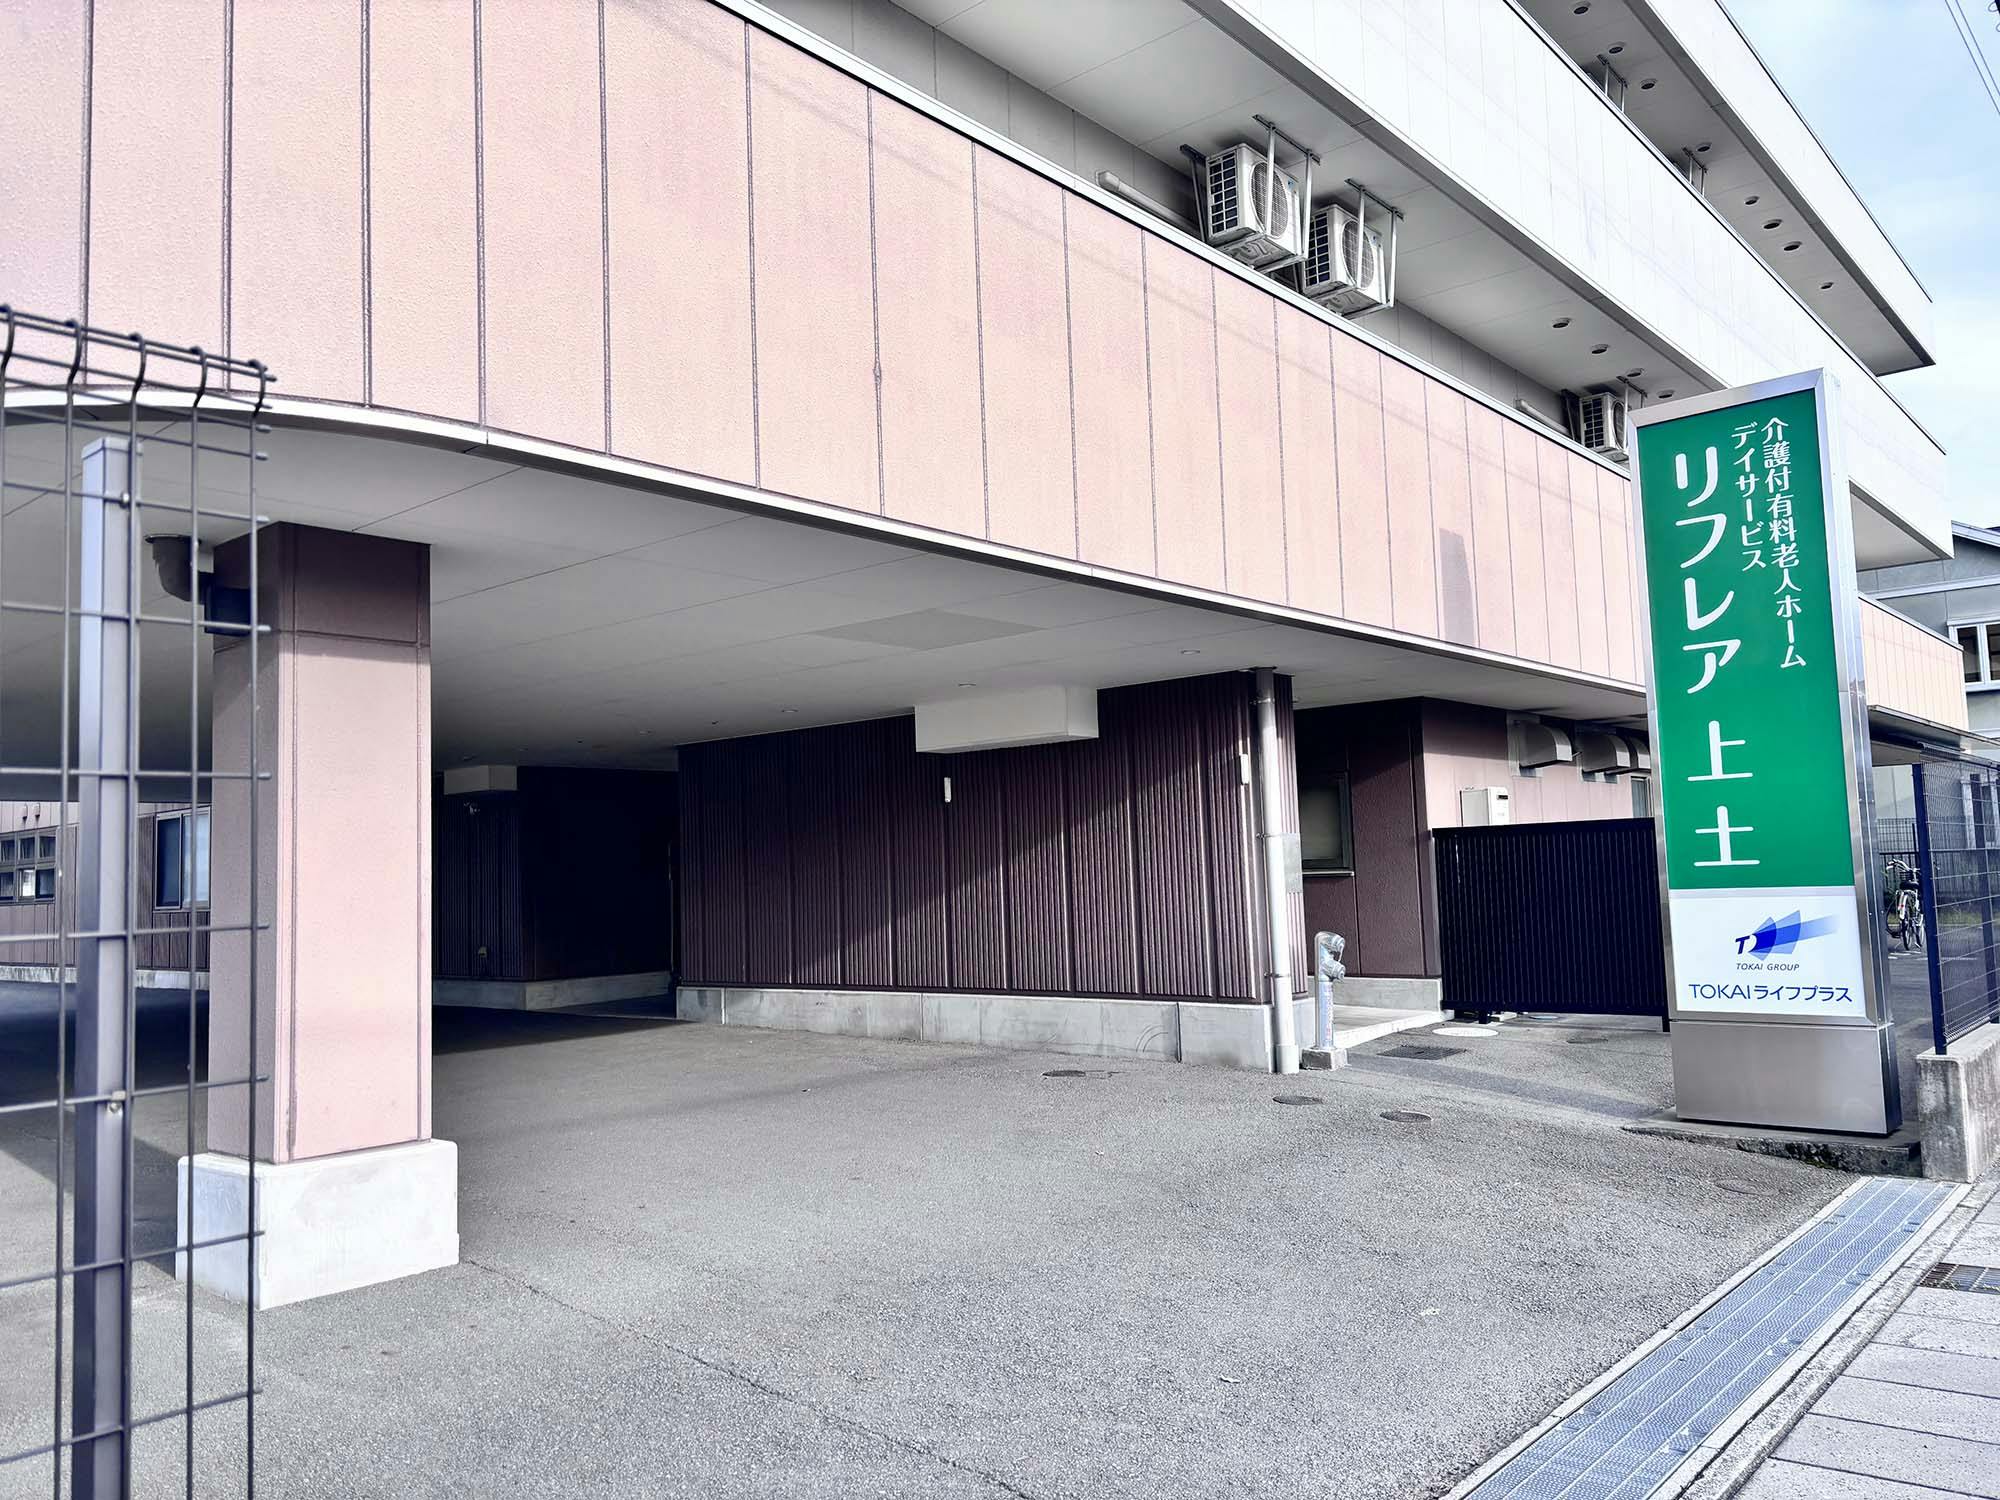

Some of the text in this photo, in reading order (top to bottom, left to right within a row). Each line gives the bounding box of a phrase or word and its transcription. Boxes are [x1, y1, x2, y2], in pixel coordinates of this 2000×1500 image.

[1731, 422, 1766, 571] デイサービス
[1761, 417, 1806, 668] 介護付有料老人ホーム
[1688, 984, 1853, 1002] TOKAIライフプラス
[1736, 962, 1800, 972] TOKAI GROUP
